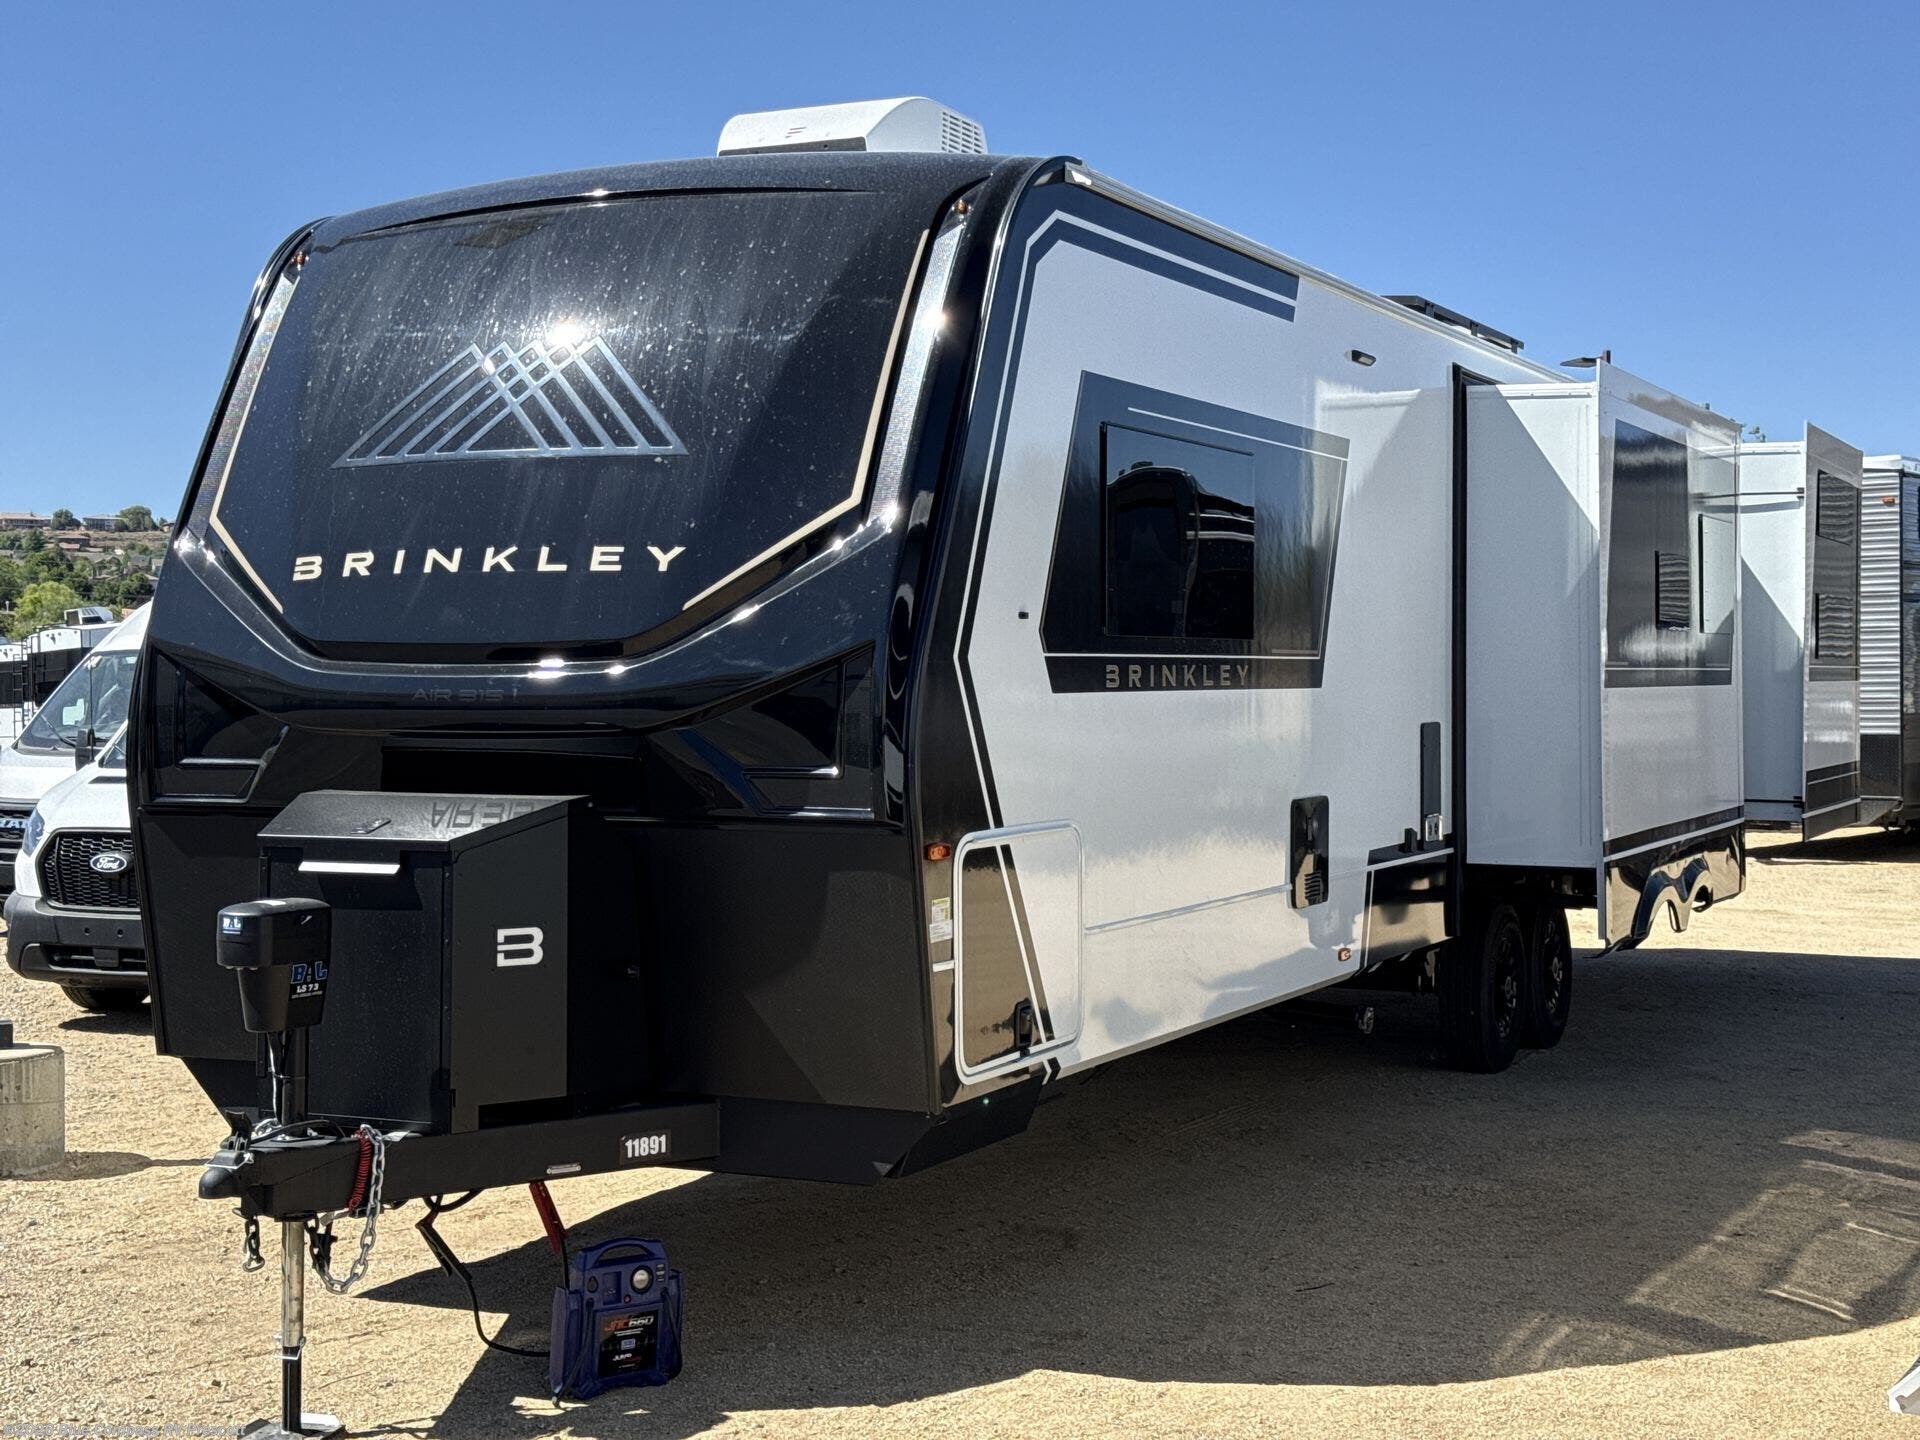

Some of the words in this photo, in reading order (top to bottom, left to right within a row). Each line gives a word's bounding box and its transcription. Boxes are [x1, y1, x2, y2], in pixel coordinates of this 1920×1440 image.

[293, 545, 687, 581] BRINKLEY
[1105, 664, 1249, 688] BRINKLEY
[411, 688, 452, 702] AIR
[97, 856, 120, 869] Ford
[296, 984, 307, 993] LS
[624, 1134, 667, 1159] 11891
